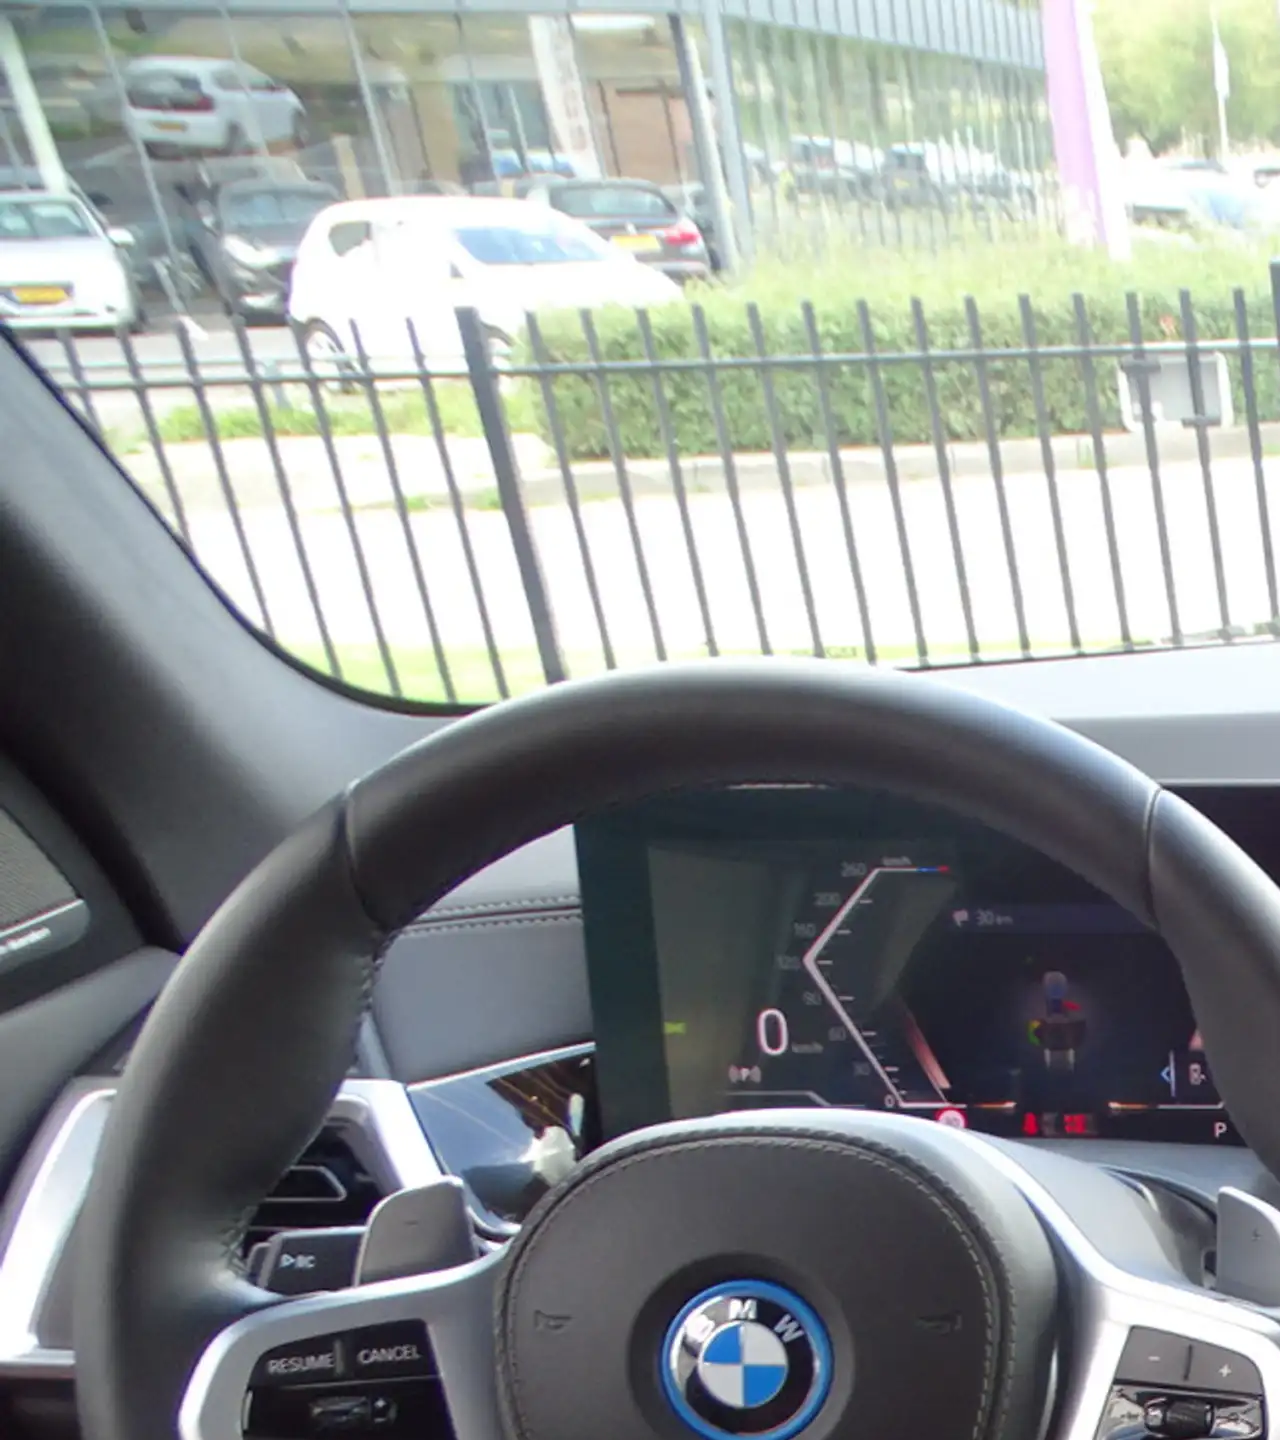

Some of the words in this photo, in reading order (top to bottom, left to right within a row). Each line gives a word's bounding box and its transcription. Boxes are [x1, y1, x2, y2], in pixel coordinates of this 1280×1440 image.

[976, 909, 994, 926] 30
[757, 1008, 788, 1056] 0
[1214, 1121, 1228, 1138] P
[267, 1352, 335, 1374] RESUME
[356, 1344, 421, 1365] CANCEL
